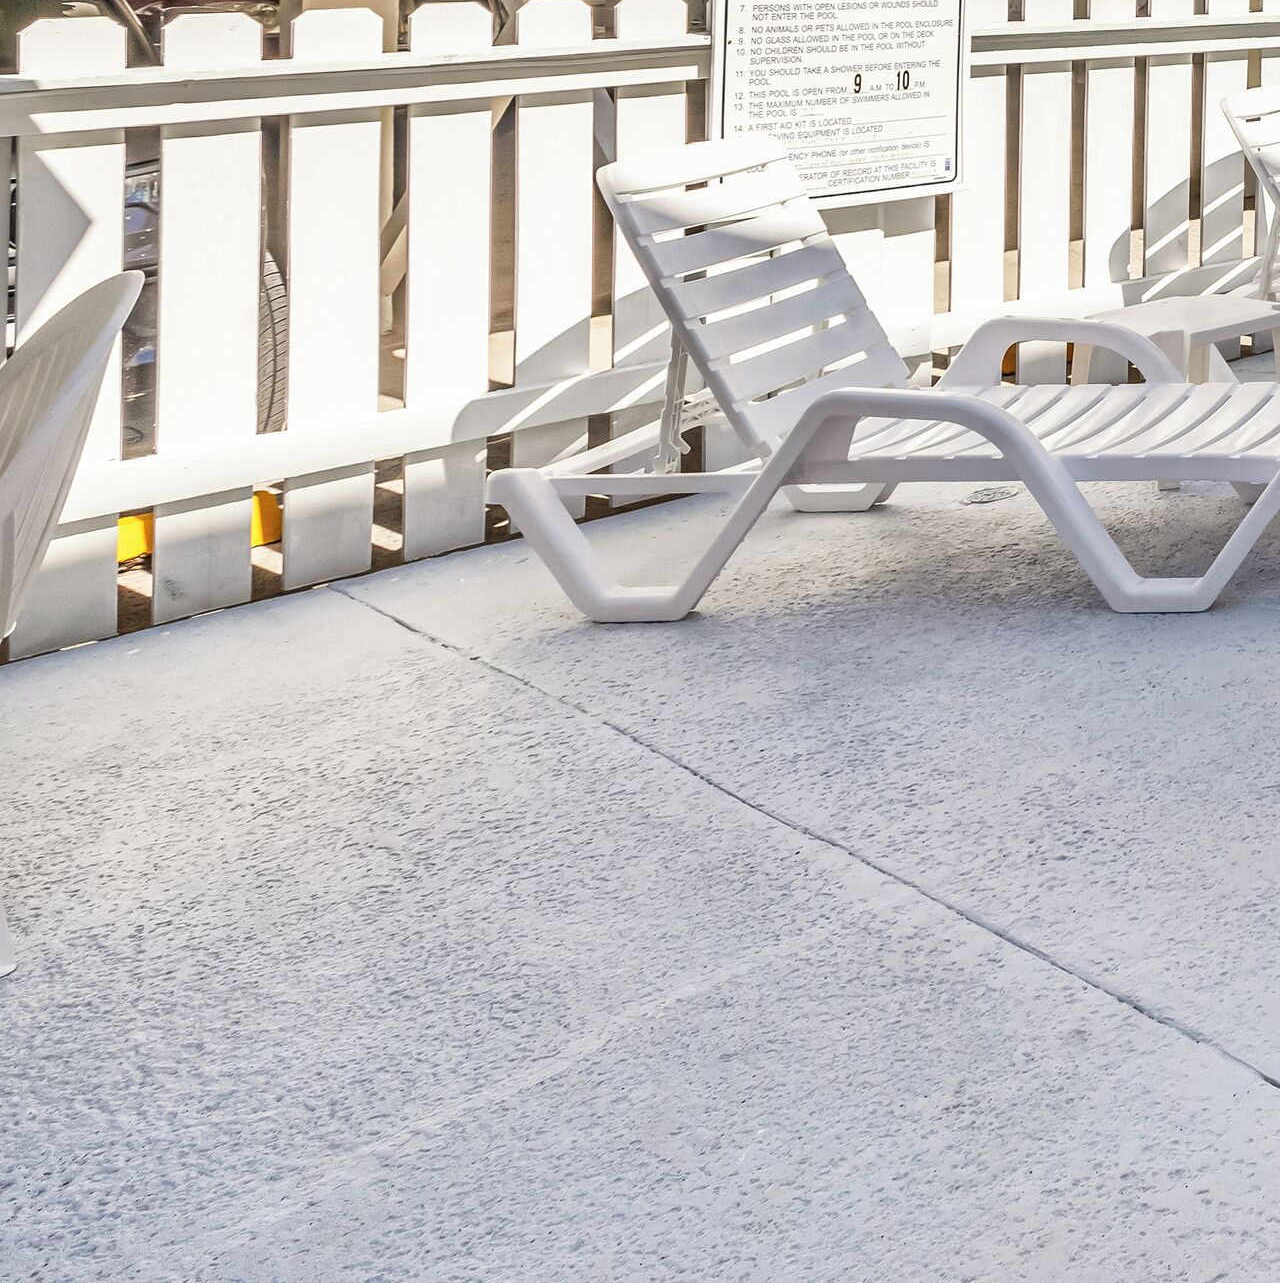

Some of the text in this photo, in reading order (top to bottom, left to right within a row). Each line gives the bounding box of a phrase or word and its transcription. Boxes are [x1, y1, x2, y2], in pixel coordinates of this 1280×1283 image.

[752, 0, 939, 12] PERSONS WITH OPEN LESIONS OR WOUNDS SHOULD
[752, 12, 815, 21] NOT ENTER THE
[750, 40, 926, 55] NO CHILDREN SHOULD BE IN THE POOL WITHOUT
[749, 59, 941, 77] YOU SHOULD TAKE A SHOWER BEFORE ENTERING THE
[749, 90, 767, 99] THIS
[769, 89, 790, 98] POOL
[792, 88, 800, 97] IS
[802, 87, 823, 96] OPEN
[826, 85, 848, 94] FROM
[854, 73, 862, 94] 9
[885, 83, 894, 91] TO
[896, 70, 910, 91] 10
